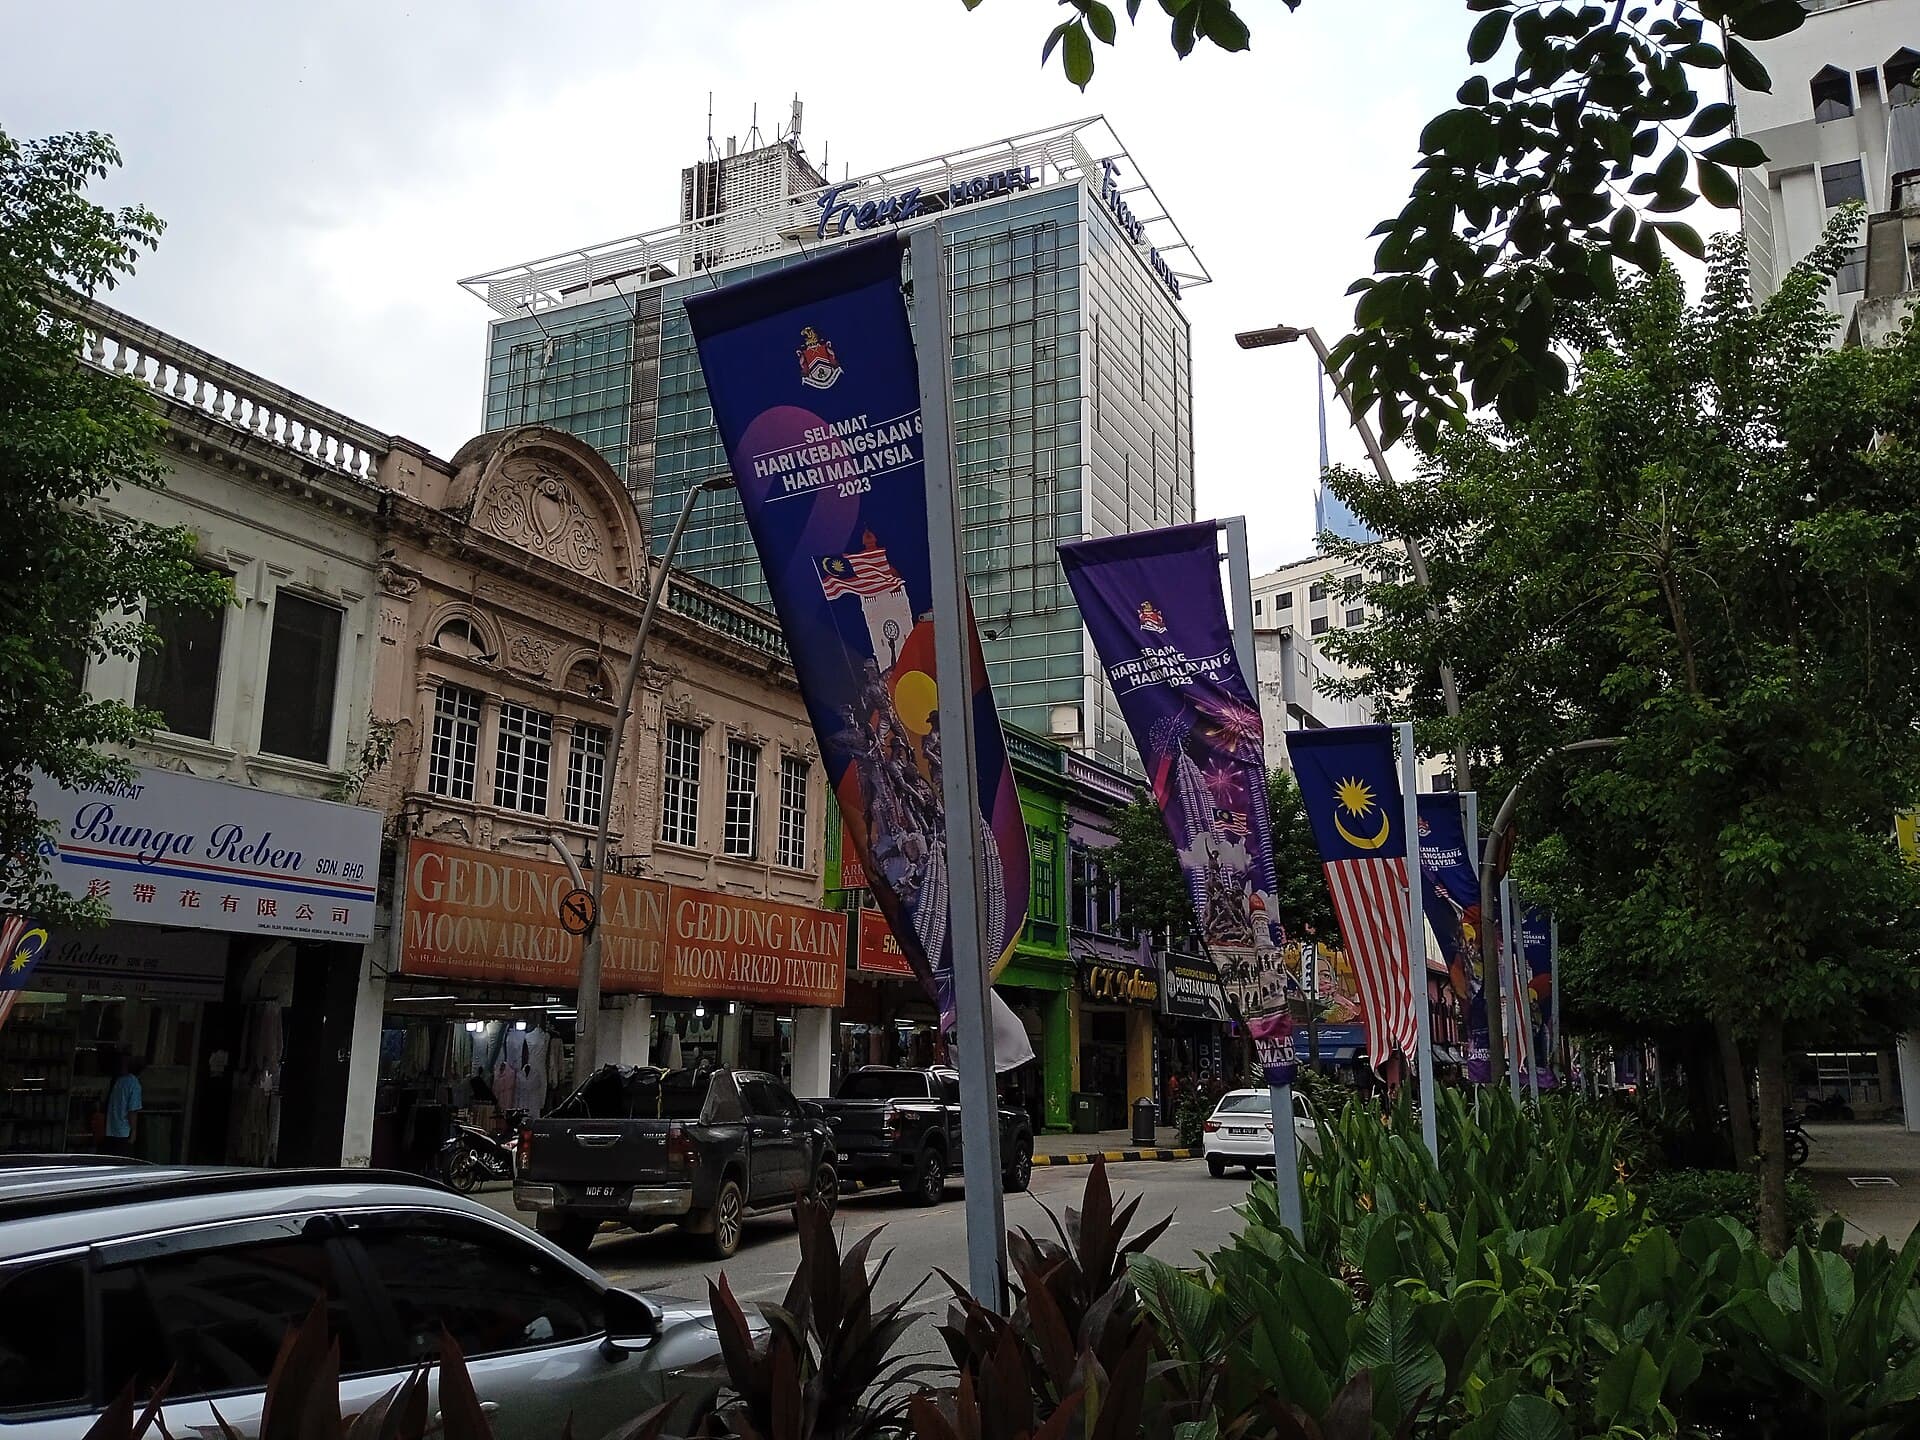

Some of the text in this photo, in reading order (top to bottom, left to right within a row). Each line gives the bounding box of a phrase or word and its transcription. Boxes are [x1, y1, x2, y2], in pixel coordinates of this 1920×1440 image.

[817, 165, 1039, 239] Frenz HOTEL
[754, 415, 923, 478] HARI KEBANGSAAN &
[804, 414, 868, 444] SELAMAT
[782, 443, 914, 492] HARI MALAYSIA
[837, 477, 872, 498] 2023
[1110, 662, 1142, 681] HARI
[1129, 671, 1160, 687] HAR
[80, 780, 145, 801] SYARIKAT
[71, 802, 195, 866] Bunga
[205, 823, 304, 872] Reben
[315, 857, 338, 875] SDN.
[342, 861, 365, 880] BHD.
[87, 877, 350, 925] 彩帶花有限公司
[409, 910, 660, 973] MOON ARKED XTILE
[676, 900, 841, 957] GEDUNG KAIN
[882, 934, 902, 955] SA
[673, 945, 727, 980] MOON
[728, 952, 781, 985] ARKED
[785, 957, 838, 990] TEXTILE
[586, 1186, 615, 1196] NDF 67
